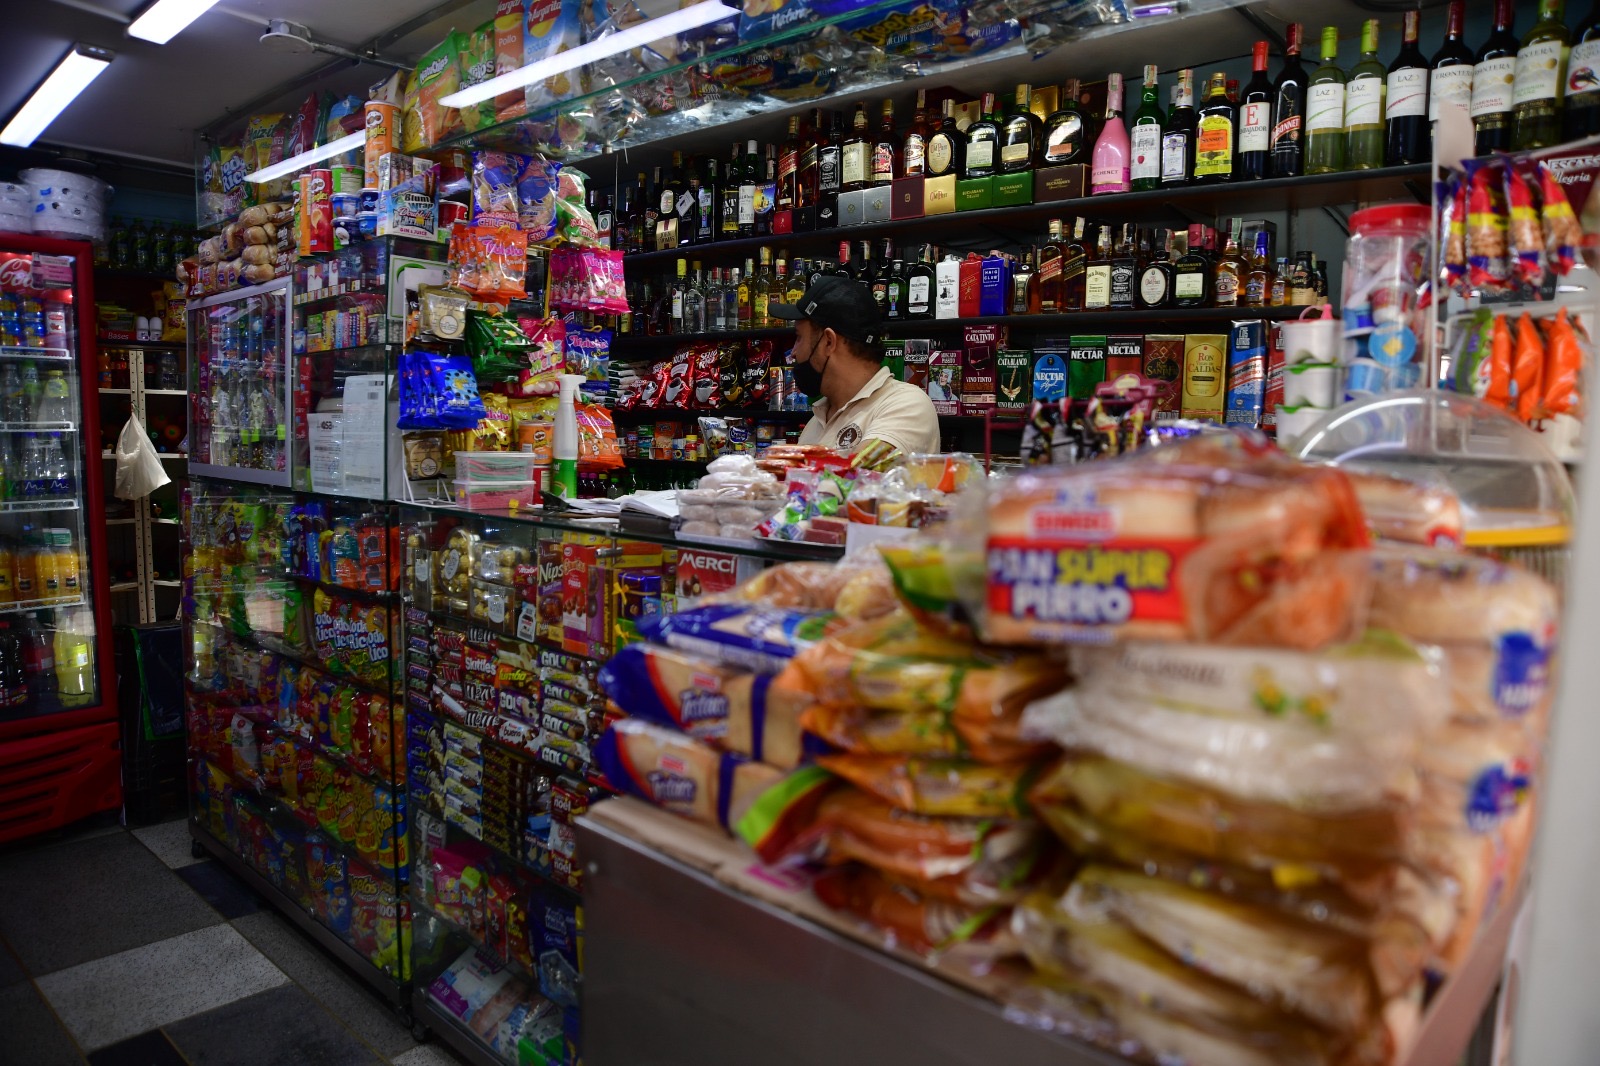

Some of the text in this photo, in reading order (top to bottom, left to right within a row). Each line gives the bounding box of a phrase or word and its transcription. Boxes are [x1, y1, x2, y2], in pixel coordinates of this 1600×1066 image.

[499, 35, 516, 46] Pollo
[1246, 105, 1258, 126] E
[404, 194, 430, 203] Blunt
[408, 202, 434, 210] Wrap
[108, 332, 129, 340] Bases
[978, 333, 994, 341] TINTO
[1071, 350, 1103, 359] NECTAR
[1108, 346, 1141, 355] NECTAR
[1009, 357, 1027, 366] BLANCO
[1198, 353, 1214, 361] RON
[1187, 364, 1221, 374] CALDAS
[1035, 372, 1064, 381] NECTAR
[539, 563, 564, 583] Nips
[541, 651, 562, 668] GOL
[465, 656, 497, 675] Skittles
[442, 663, 461, 681] TWI
[541, 714, 563, 731] GOL
[504, 726, 521, 738] bueno
[541, 746, 563, 765] GOL
[553, 798, 571, 812] noel
[553, 861, 571, 875] noel
